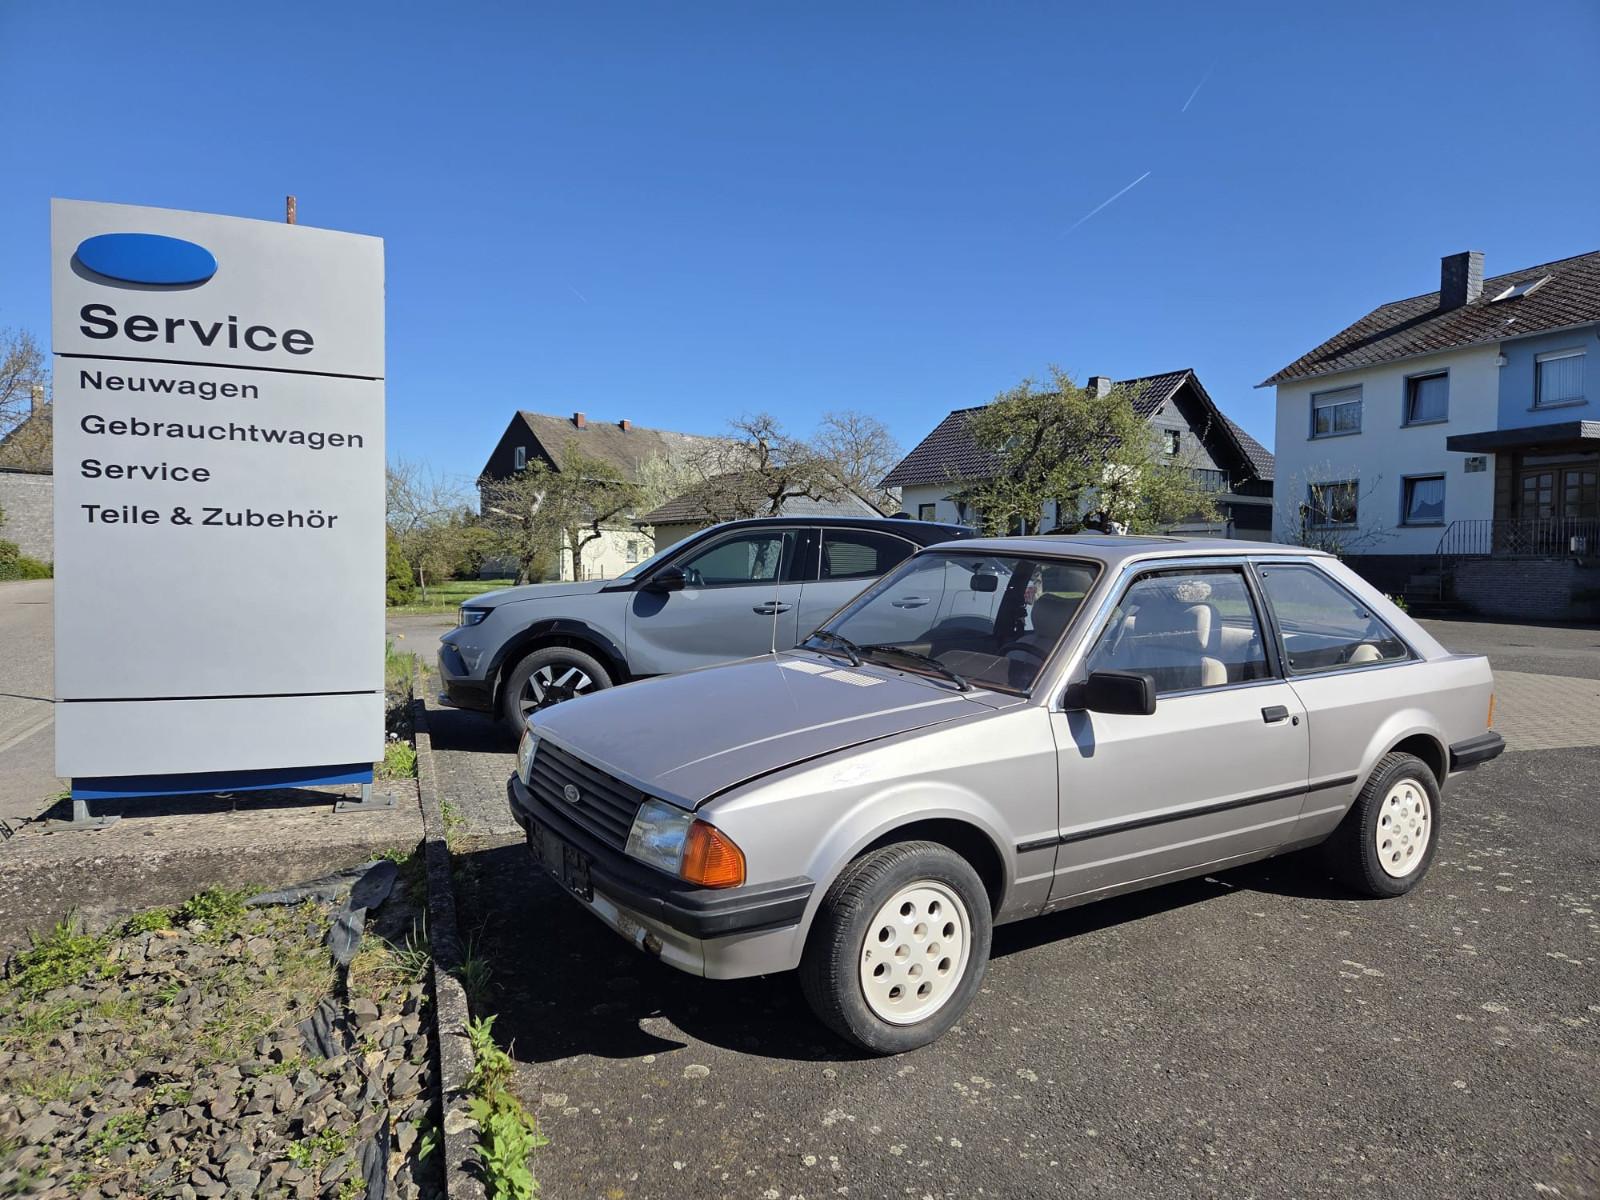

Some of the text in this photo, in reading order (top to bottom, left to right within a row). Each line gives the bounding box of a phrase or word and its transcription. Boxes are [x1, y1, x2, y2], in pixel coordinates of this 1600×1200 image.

[79, 303, 315, 356] Service
[80, 370, 259, 400] Neuwagen
[80, 414, 364, 450] Gebrauchtwagen
[80, 459, 211, 483] Service
[81, 504, 338, 529] Teile & Zubehör
